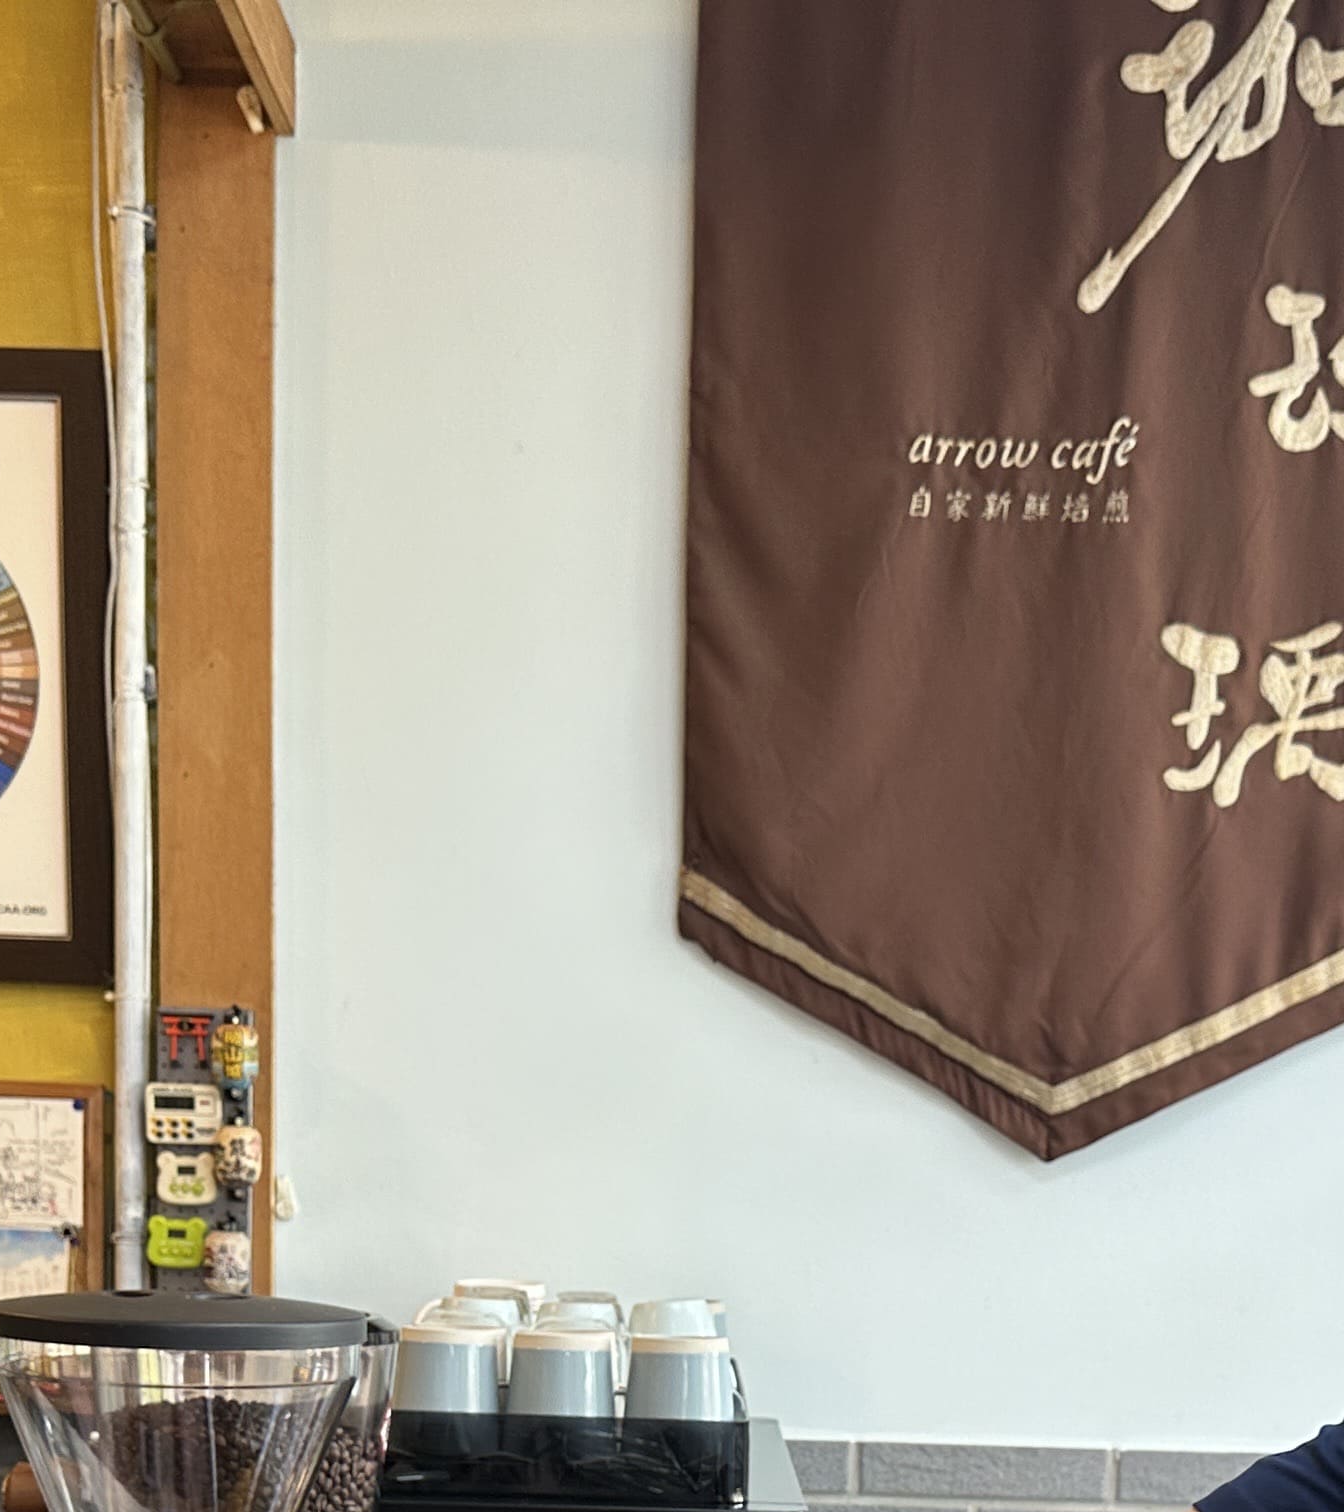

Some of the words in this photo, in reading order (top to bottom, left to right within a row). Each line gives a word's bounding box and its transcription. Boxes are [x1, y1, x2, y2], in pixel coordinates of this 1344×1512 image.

[908, 432, 1040, 470] arrow
[1050, 415, 1140, 486] café
[907, 484, 1131, 524] 自家新鮮焙煎
